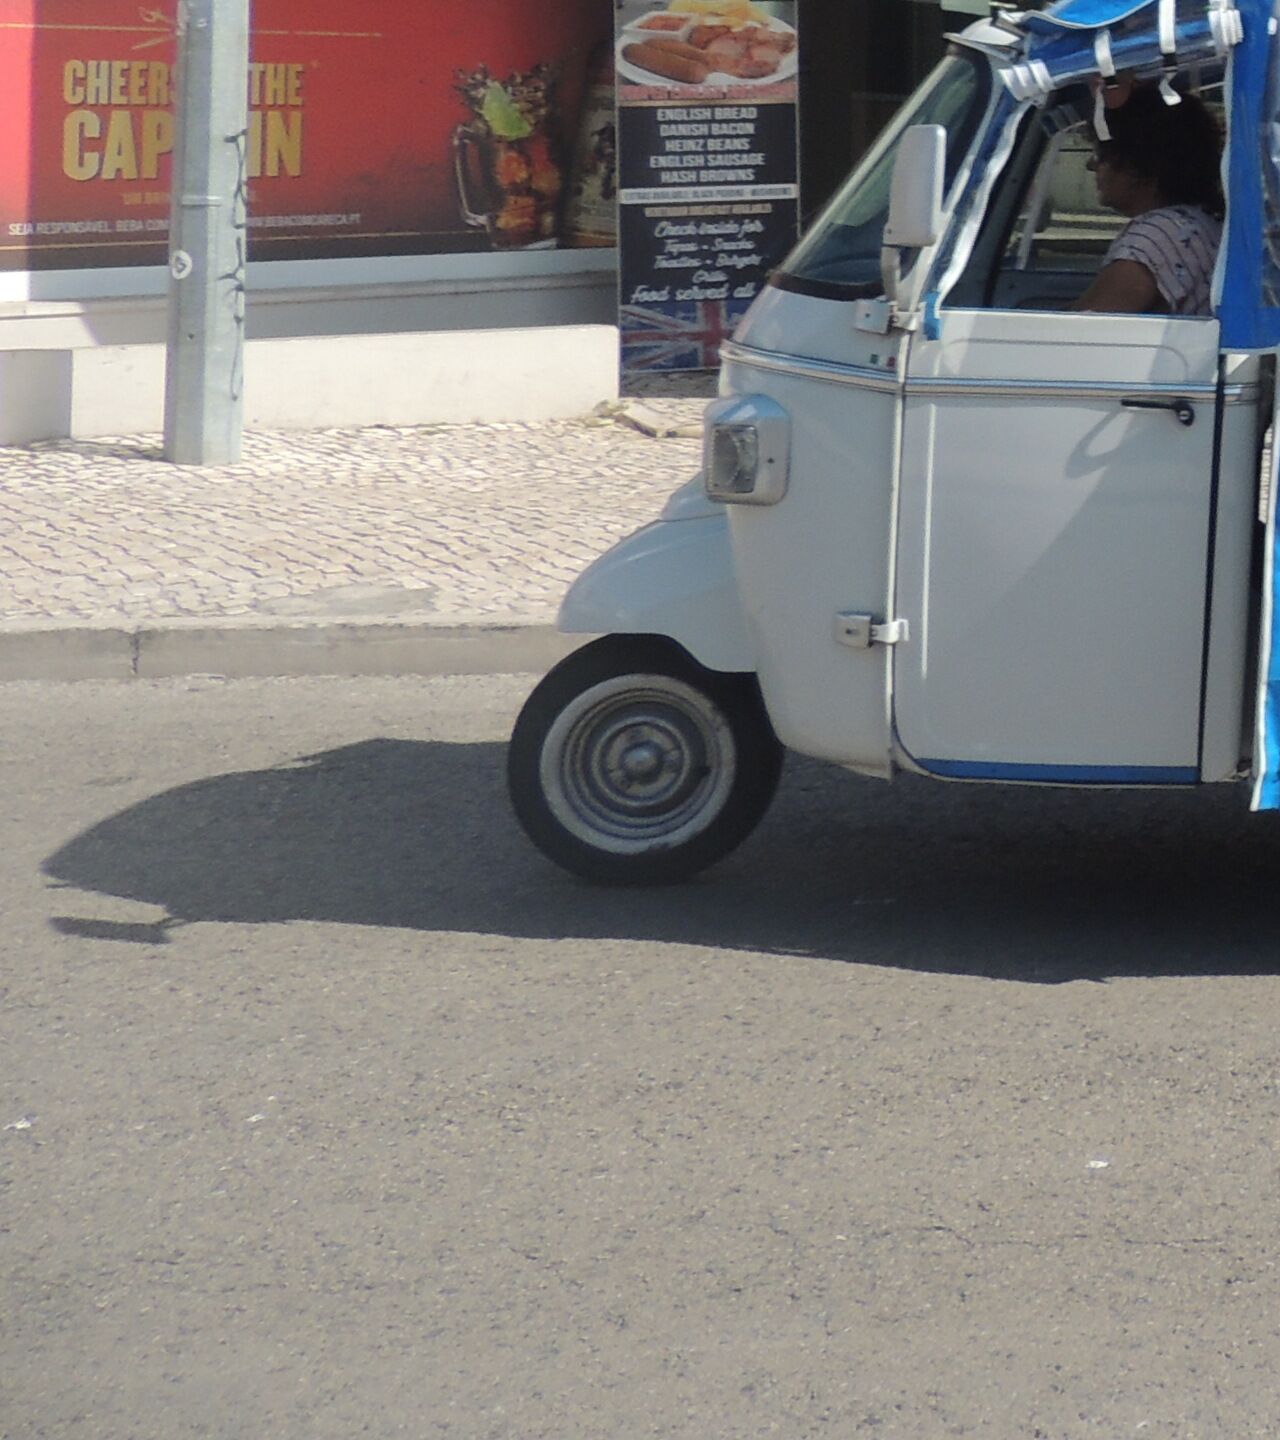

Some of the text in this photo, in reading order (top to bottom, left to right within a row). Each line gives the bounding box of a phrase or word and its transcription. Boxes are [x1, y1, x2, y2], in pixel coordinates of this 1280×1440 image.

[64, 59, 304, 107] CHEER THE
[657, 107, 757, 121] ENGLISH BREAD
[660, 123, 755, 136] DANISH BACON
[63, 109, 302, 181] CAPIN
[665, 138, 750, 152] HEINZ BEANS
[650, 153, 766, 169] ENGLISH SAUSAGE
[661, 169, 755, 183] HASH BROWNS
